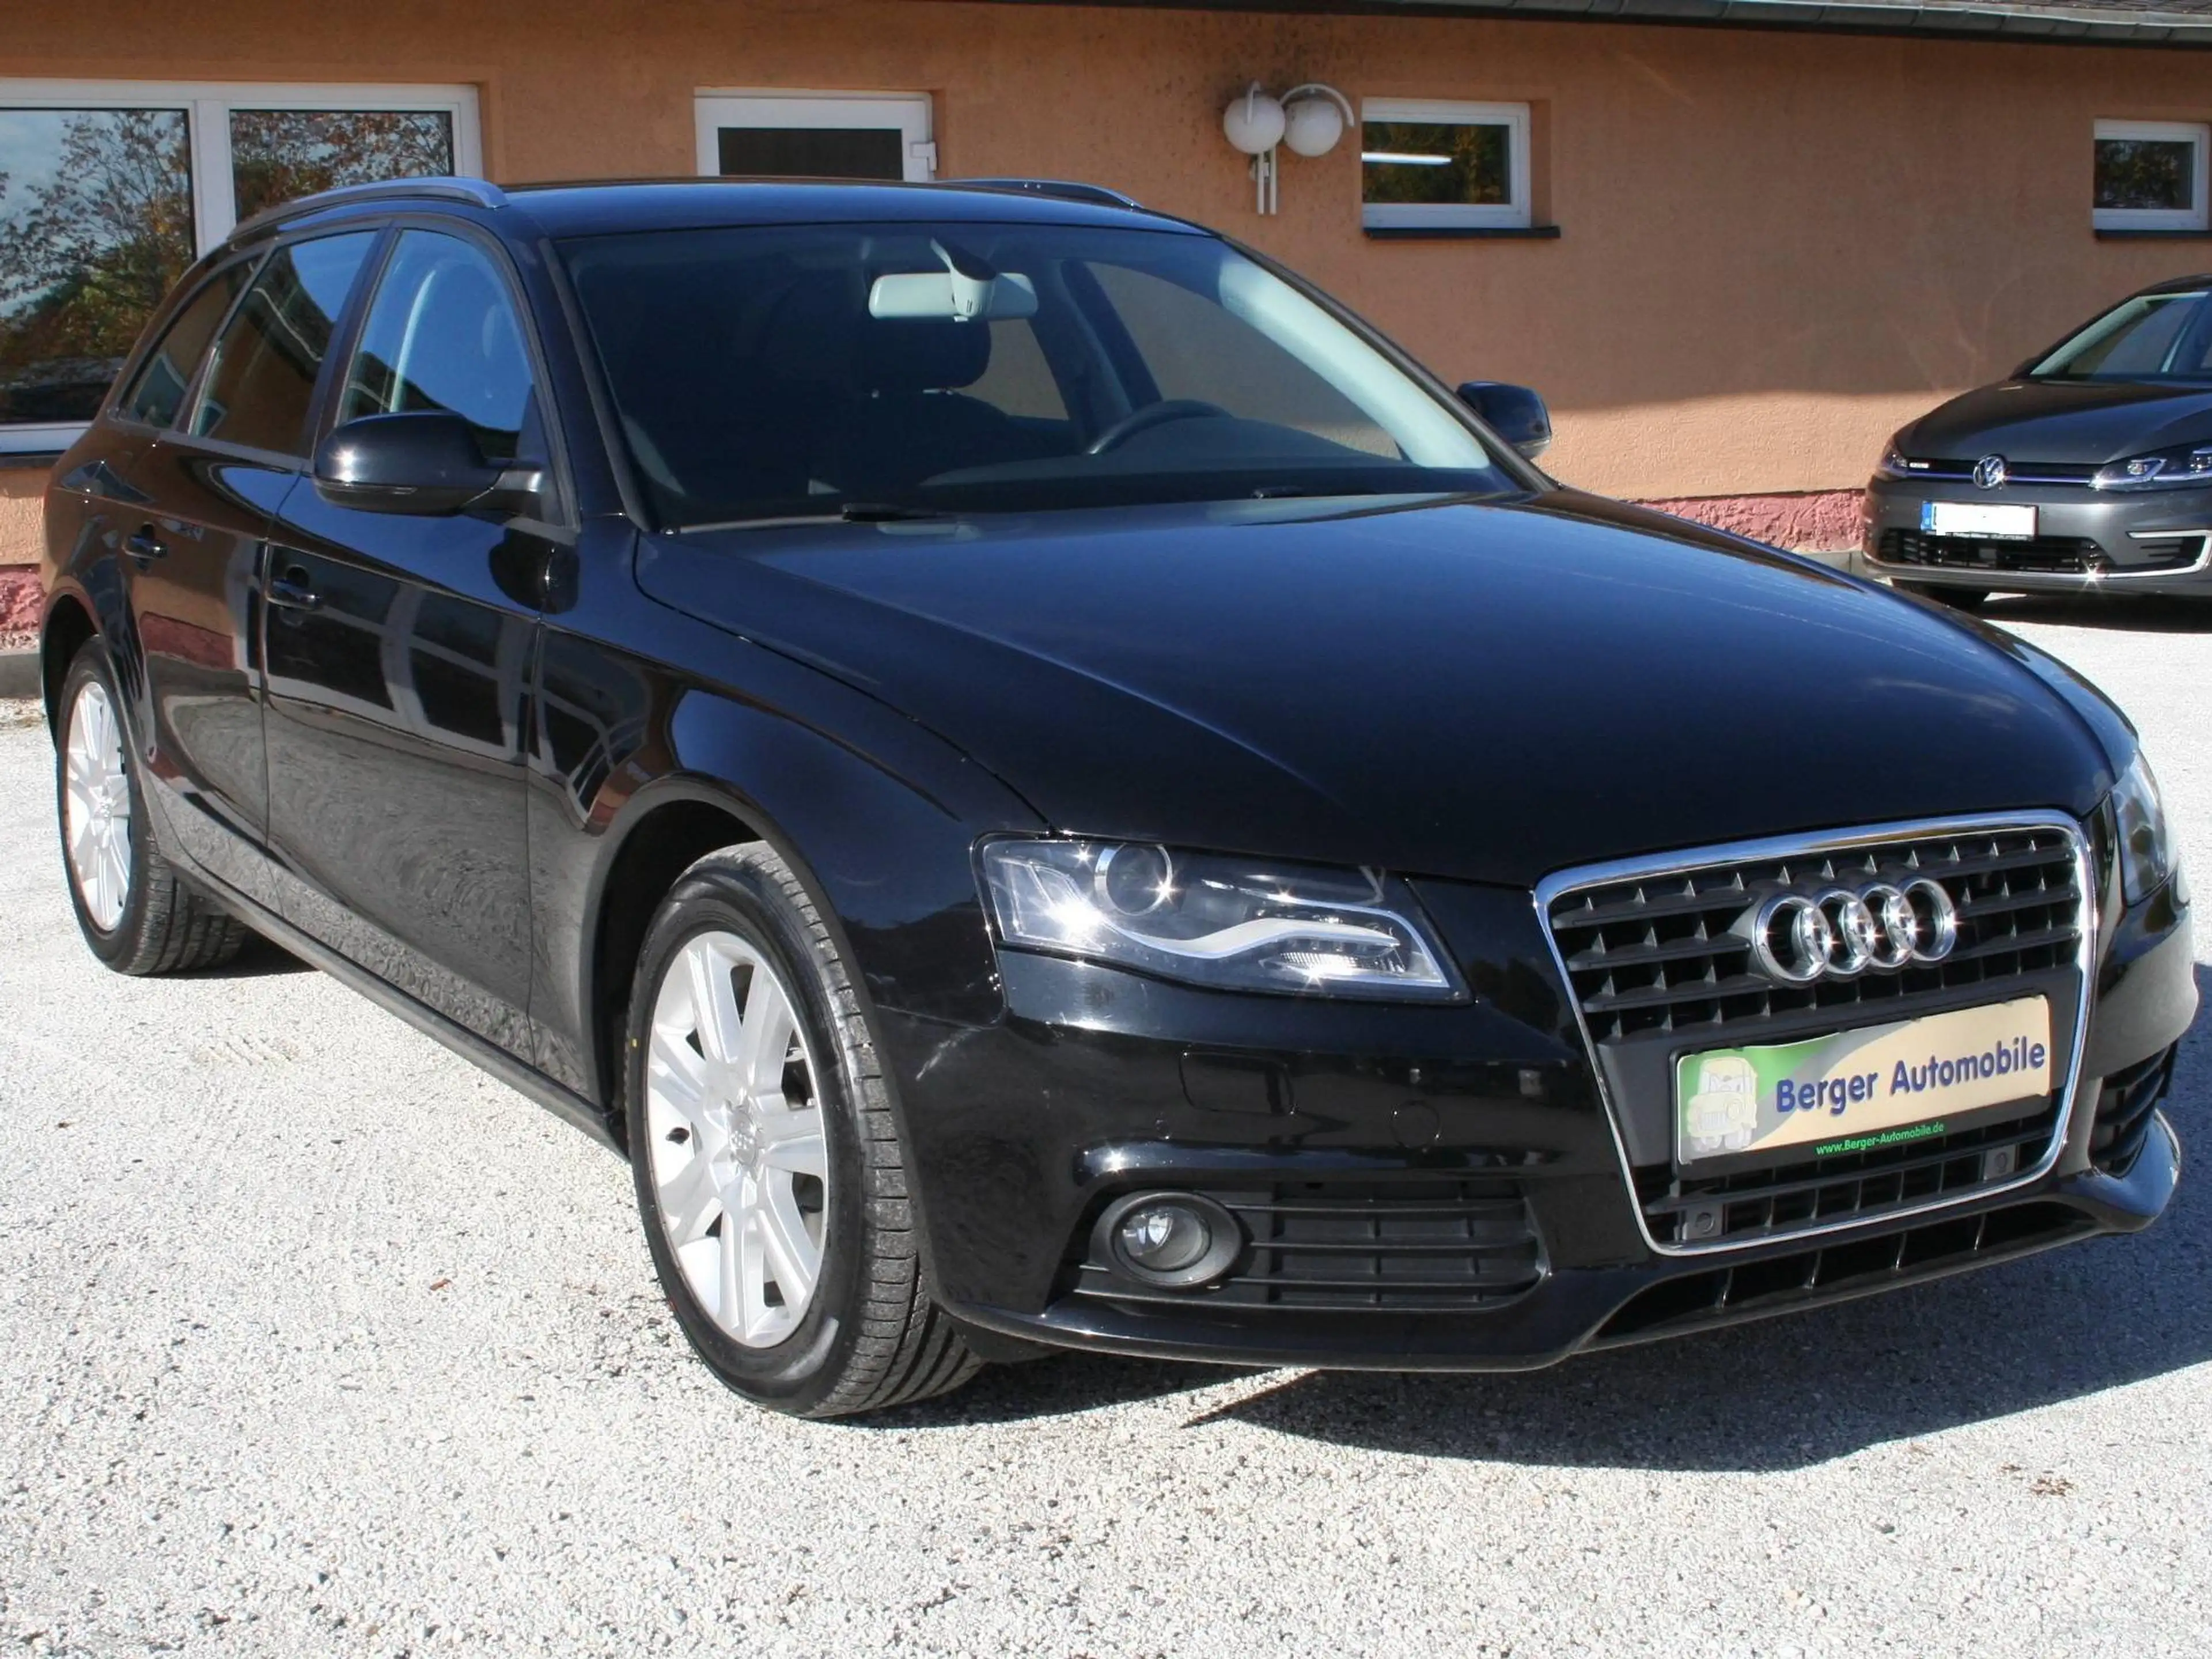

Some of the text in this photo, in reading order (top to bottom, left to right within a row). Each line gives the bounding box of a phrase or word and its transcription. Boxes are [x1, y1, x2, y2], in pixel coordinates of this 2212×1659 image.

[1776, 1035, 2045, 1116] Berger Automobile
[1816, 1122, 1945, 1155] www.Berger-Automobile.de
